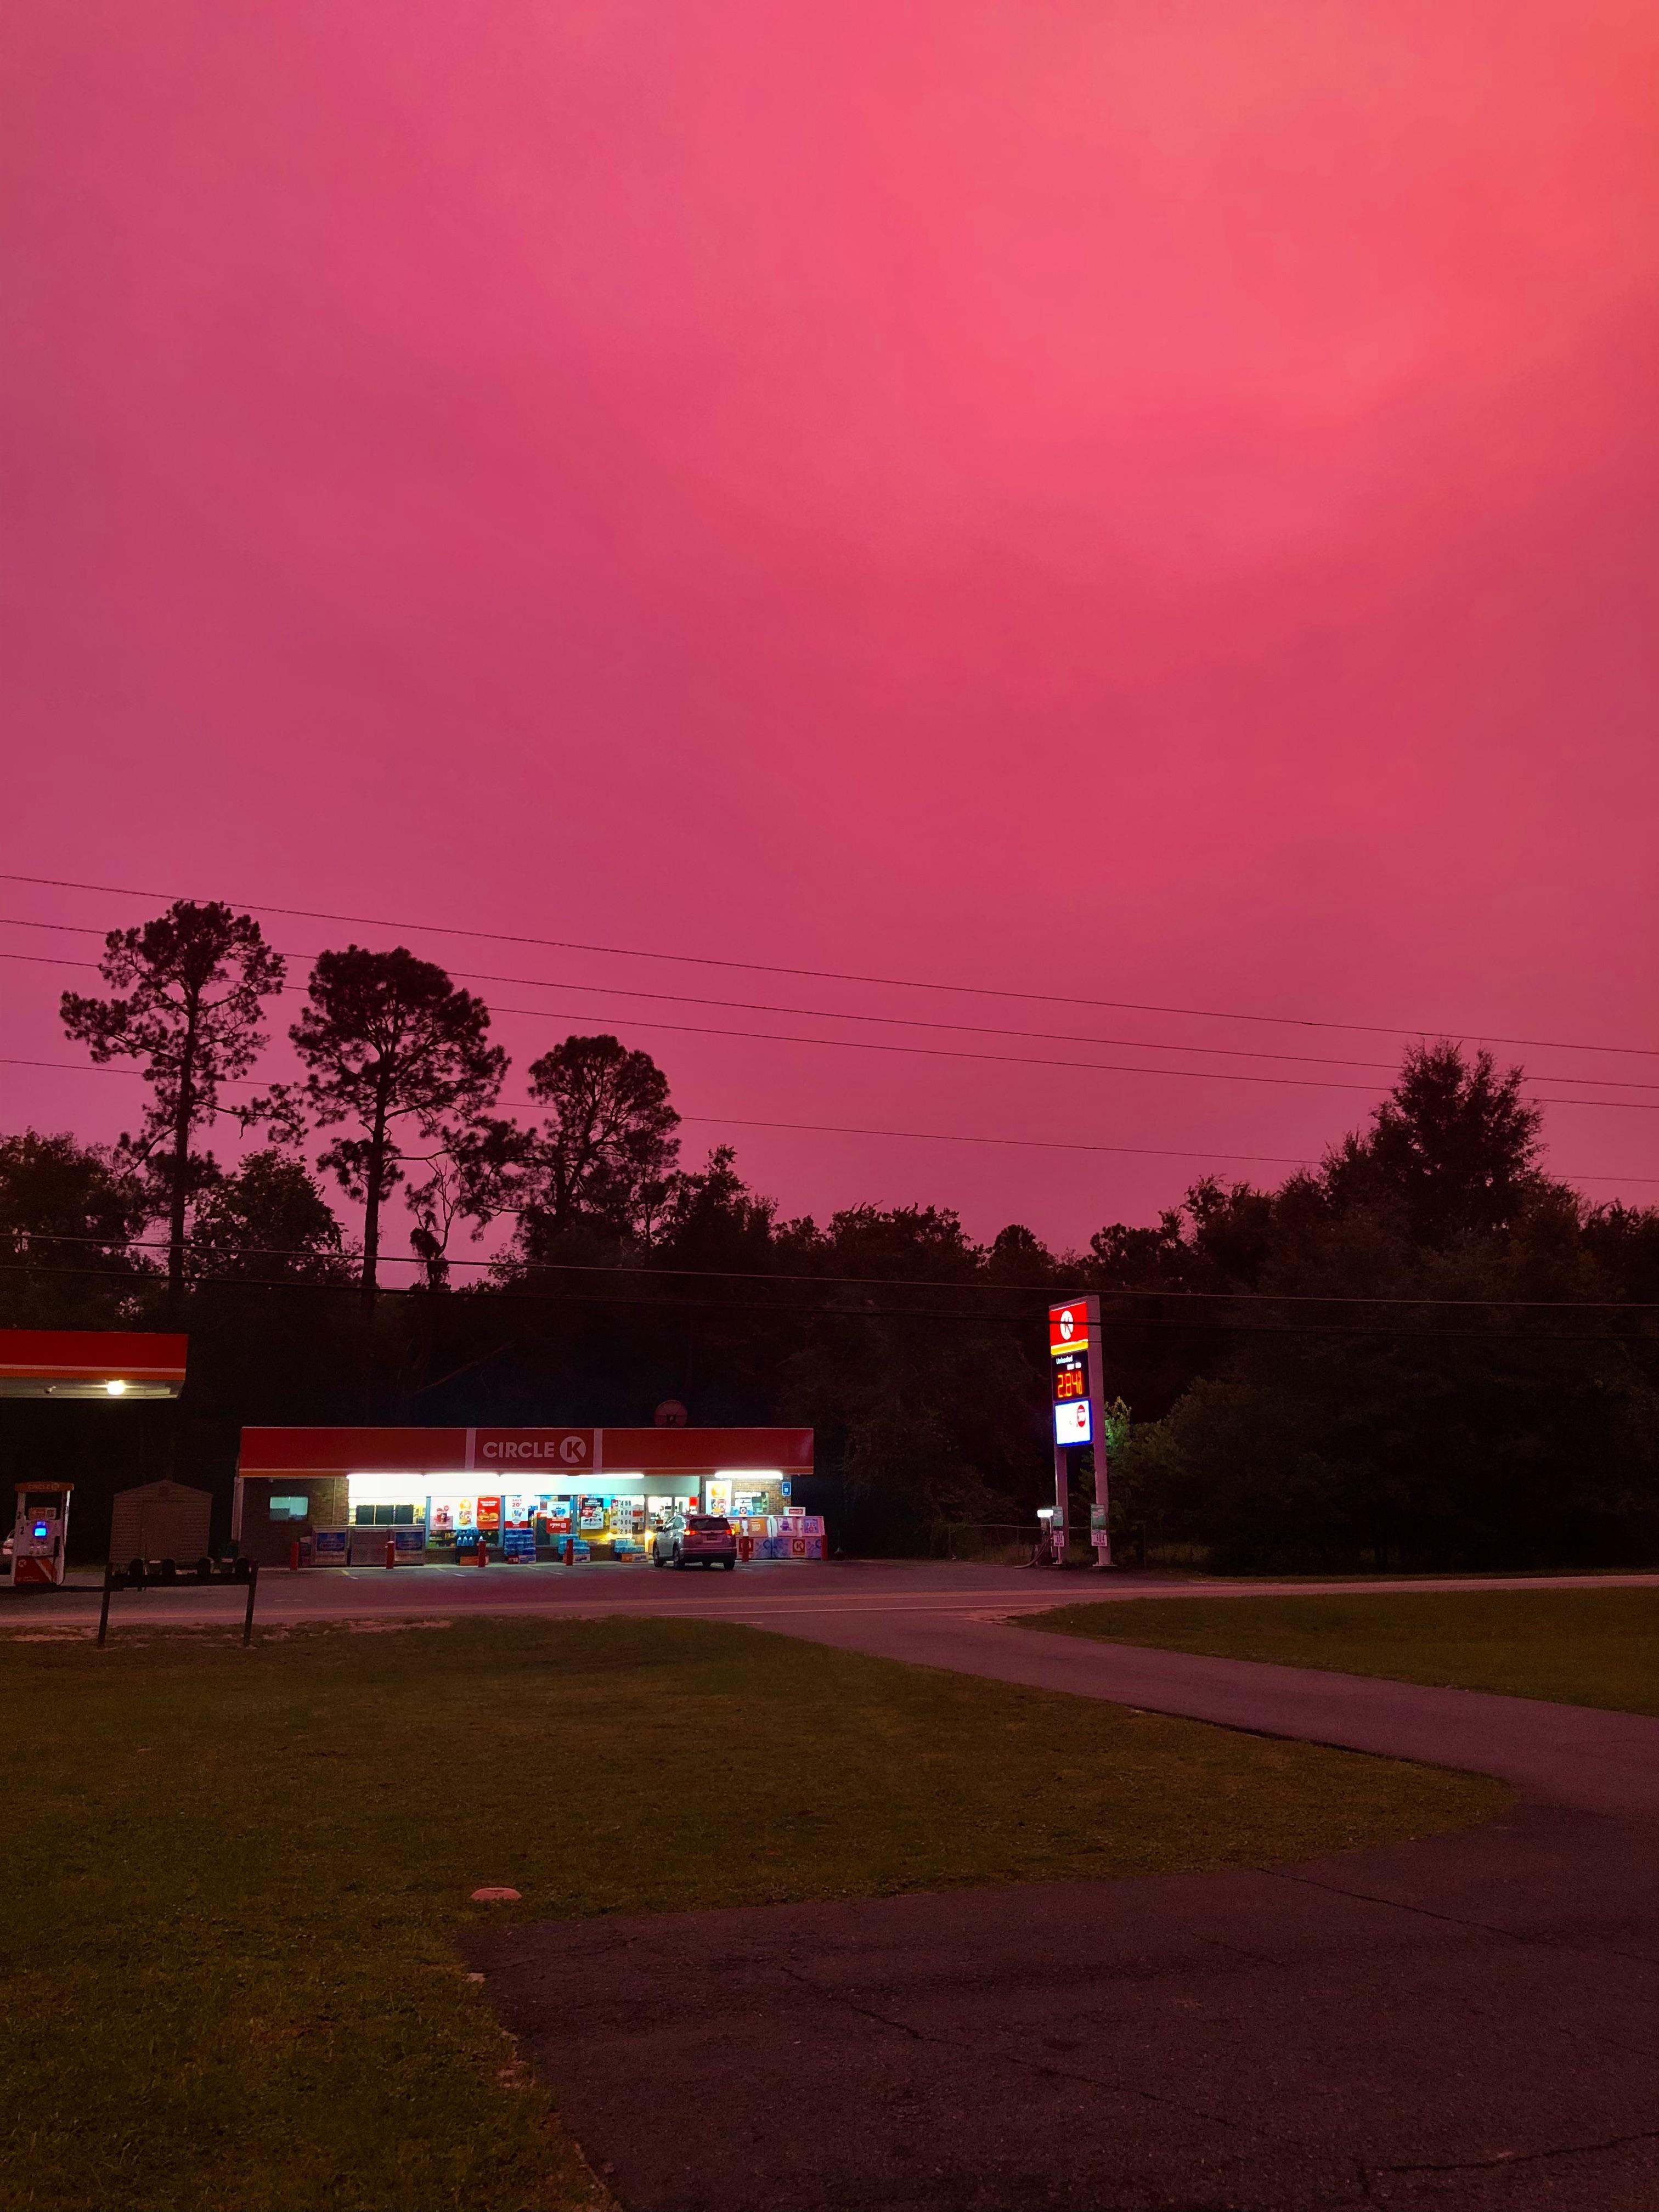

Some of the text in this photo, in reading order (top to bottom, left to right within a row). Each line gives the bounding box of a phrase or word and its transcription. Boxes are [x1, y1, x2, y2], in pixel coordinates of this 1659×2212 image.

[1062, 1313, 1073, 1339] K
[483, 1438, 586, 1462] CIRCLE K
[794, 1541, 804, 1551] K
